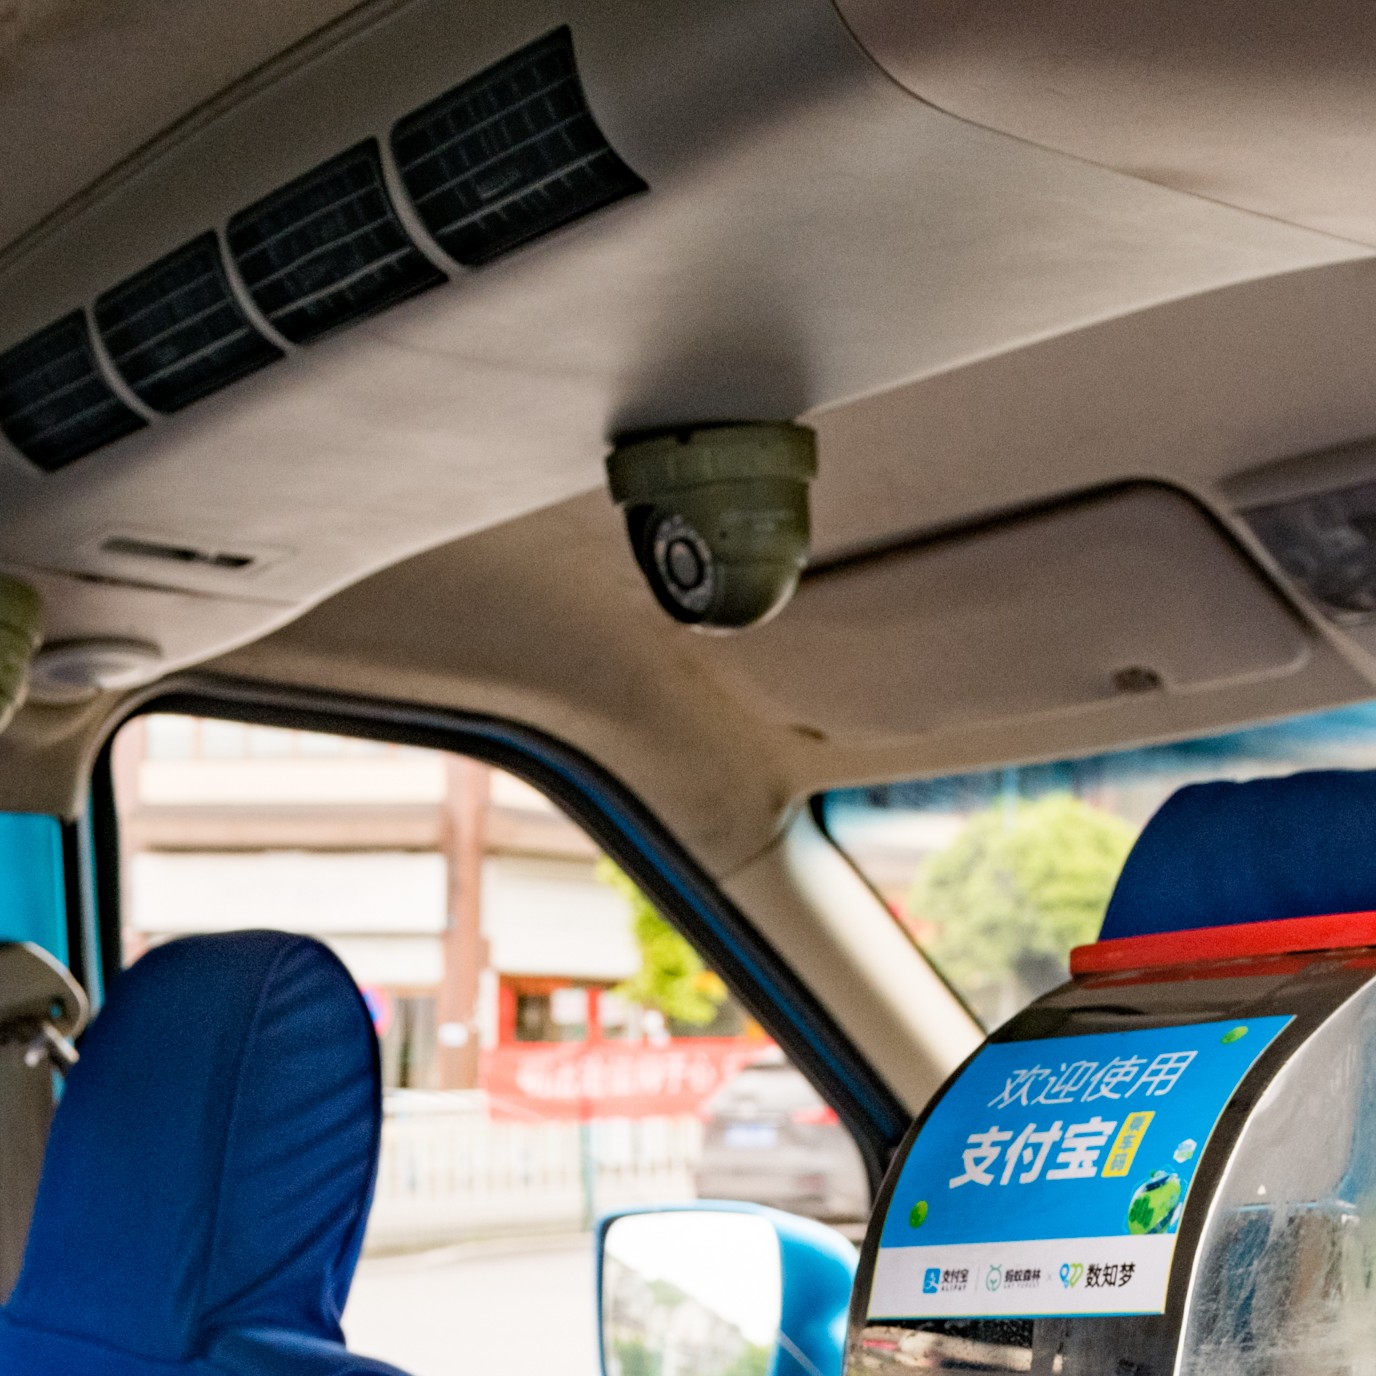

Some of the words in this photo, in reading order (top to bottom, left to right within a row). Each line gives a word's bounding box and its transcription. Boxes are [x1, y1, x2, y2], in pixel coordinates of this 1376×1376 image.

[987, 1050, 1198, 1110] 欢迎使用
[948, 1115, 1118, 1189] 支付宝
[942, 1268, 969, 1284] 支付宝
[1085, 1261, 1136, 1289] 数知梦
